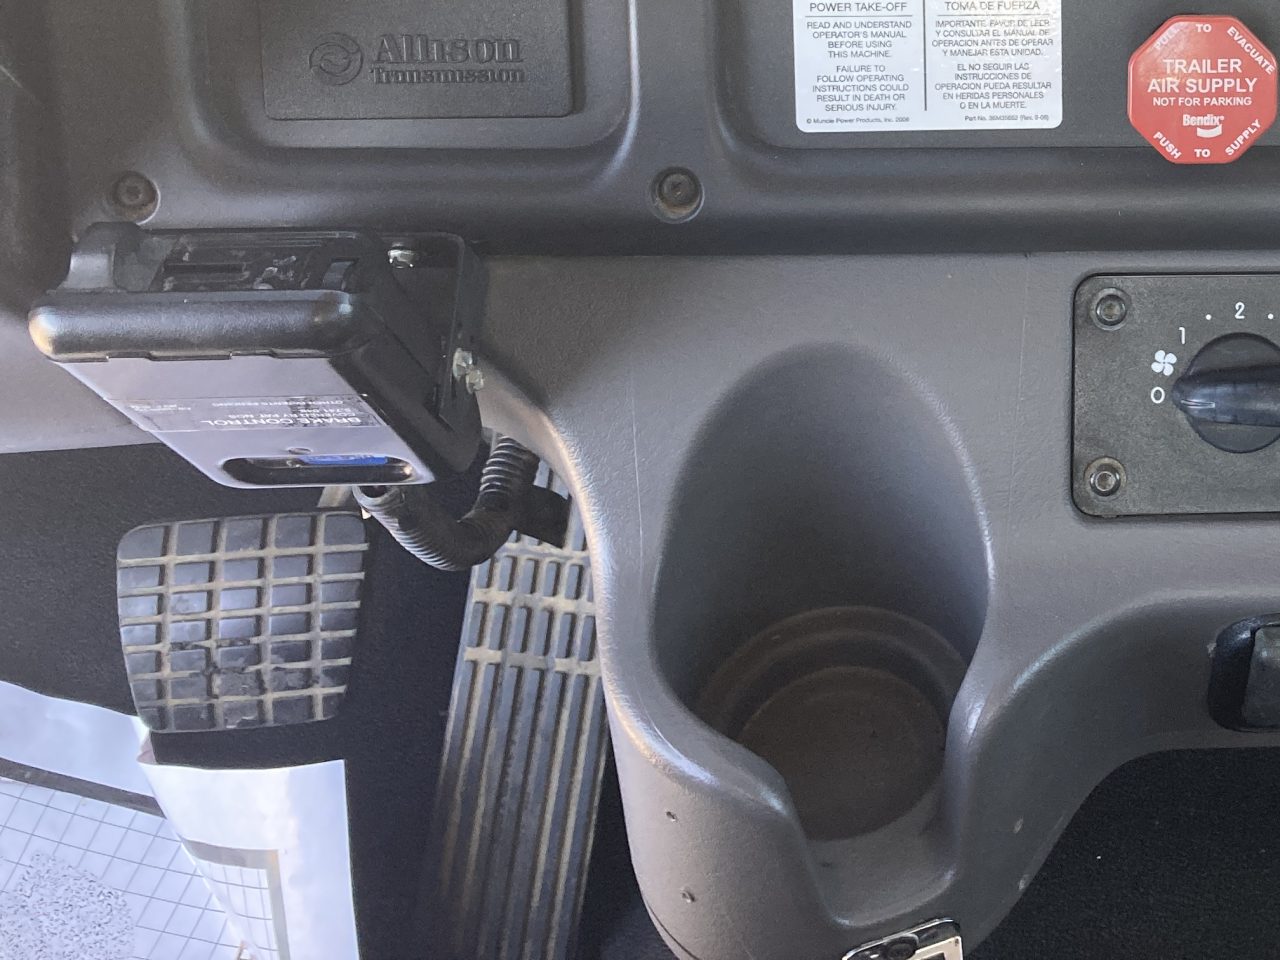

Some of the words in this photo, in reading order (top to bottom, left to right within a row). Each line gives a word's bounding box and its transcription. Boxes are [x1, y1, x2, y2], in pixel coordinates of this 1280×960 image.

[810, 3, 851, 12] POWER
[855, 2, 908, 12] TAKE-OFF
[945, 2, 977, 11] TOMA
[979, 1, 995, 10] DE
[998, 1, 1040, 10] FUERZA
[833, 21, 851, 29] AND
[854, 21, 912, 29] UNDERSTAND
[812, 31, 868, 39] OPERATOR'S
[851, 50, 892, 58] MACHINE.
[1155, 26, 1180, 50] PULL
[1196, 24, 1212, 33] TO
[1227, 26, 1276, 75] EVACUATE
[836, 65, 872, 73] FAILURE
[957, 64, 967, 72] EL
[969, 63, 981, 71] NO
[983, 63, 1013, 71] SEGUIR
[1015, 62, 1029, 70] LAS
[1163, 59, 1242, 73] TRAILER
[817, 75, 854, 83] FOLLOW
[955, 73, 1019, 81] INSTRUCCIONES
[1021, 72, 1032, 80] DE
[812, 84, 877, 92] INSTRUCTIONS
[880, 84, 909, 92] COULD
[1147, 78, 1180, 93] AIR
[1186, 78, 1258, 93] SUPPLY
[852, 94, 861, 102] IN
[864, 94, 890, 102] DEATH
[893, 93, 906, 101] OR
[1153, 97, 1176, 106] NOT
[1179, 97, 1200, 106] FOR
[1204, 97, 1252, 106] PARKING
[866, 103, 897, 111] INJURY.
[1183, 114, 1221, 126] Bendix
[1153, 132, 1182, 159] PUSH
[1194, 149, 1211, 157] TO
[1225, 119, 1262, 156] SUPPLY
[1234, 302, 1245, 319] 2
[1179, 327, 1186, 345] 1
[1151, 387, 1165, 404] 0
[200, 417, 295, 426] CONTROL
[297, 417, 362, 425] BRAKE
